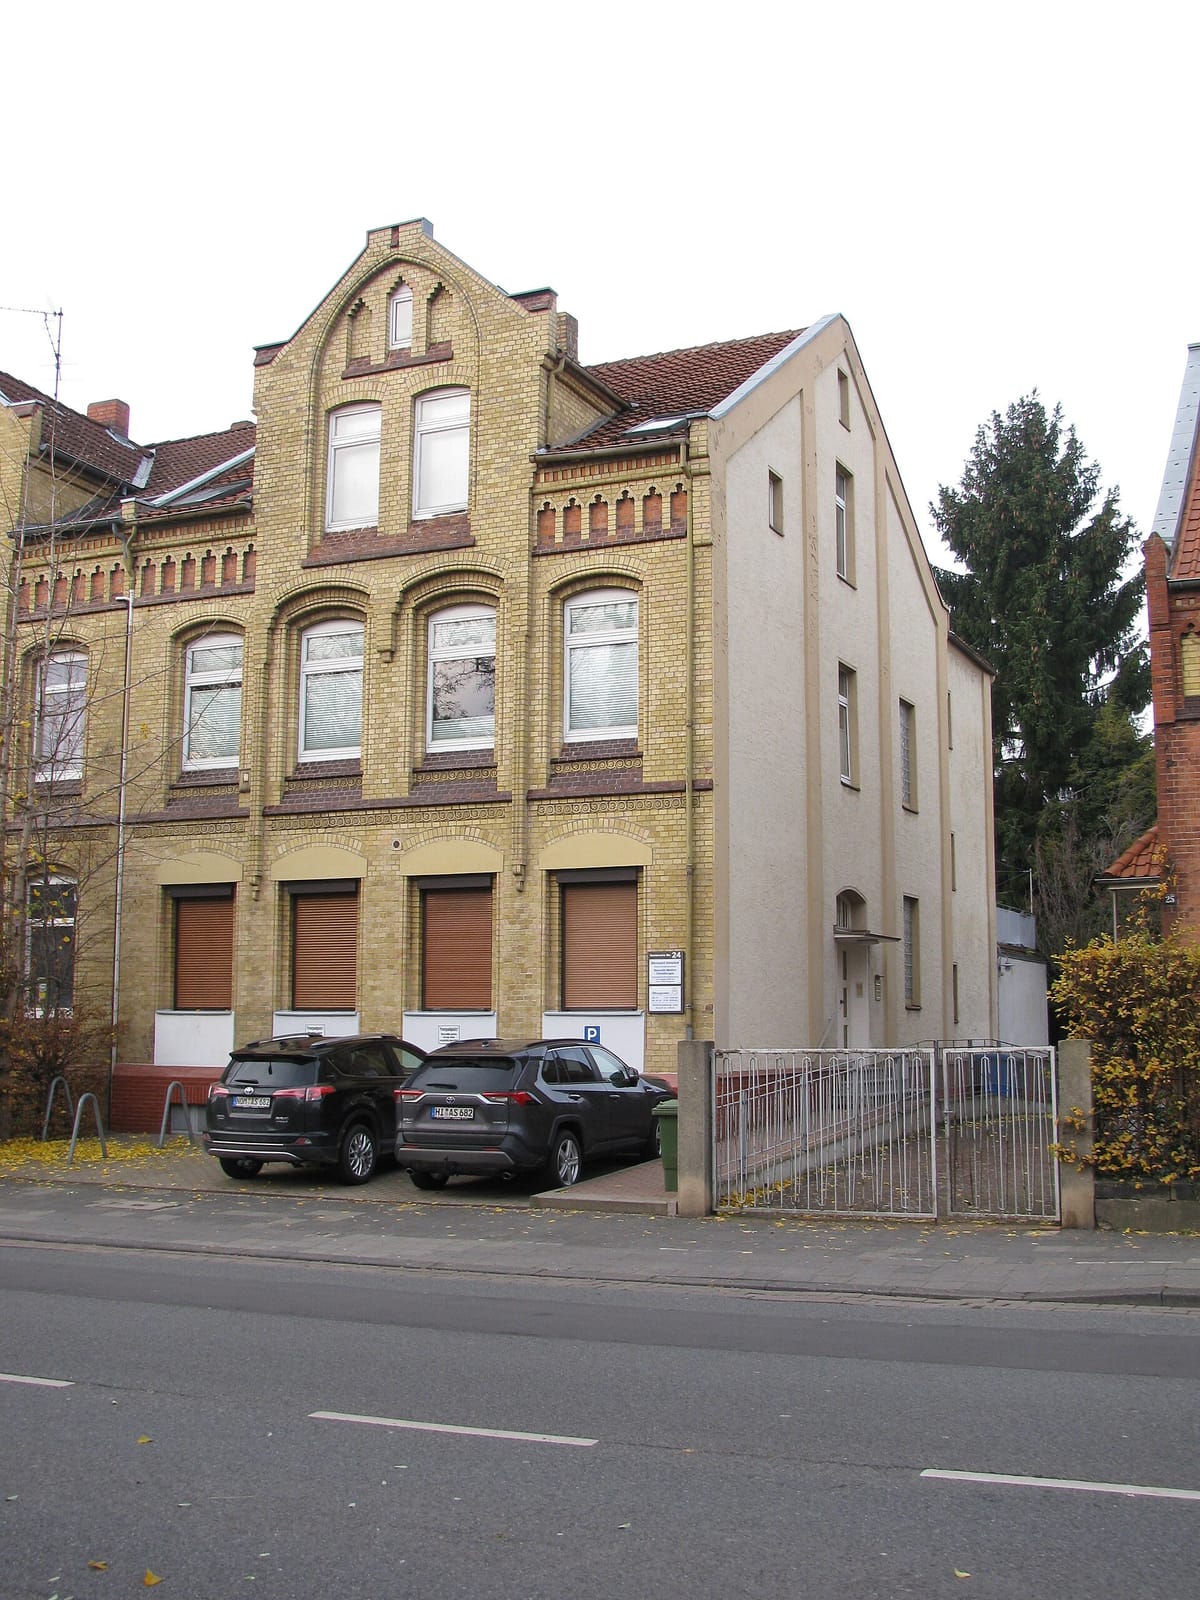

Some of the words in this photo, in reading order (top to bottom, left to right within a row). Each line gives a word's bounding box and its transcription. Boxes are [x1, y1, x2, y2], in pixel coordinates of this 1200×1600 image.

[671, 951, 681, 959] 24
[587, 1027, 598, 1041] P
[435, 1108, 444, 1116] HI
[449, 1109, 458, 1117] AS
[460, 1109, 473, 1118] 682
